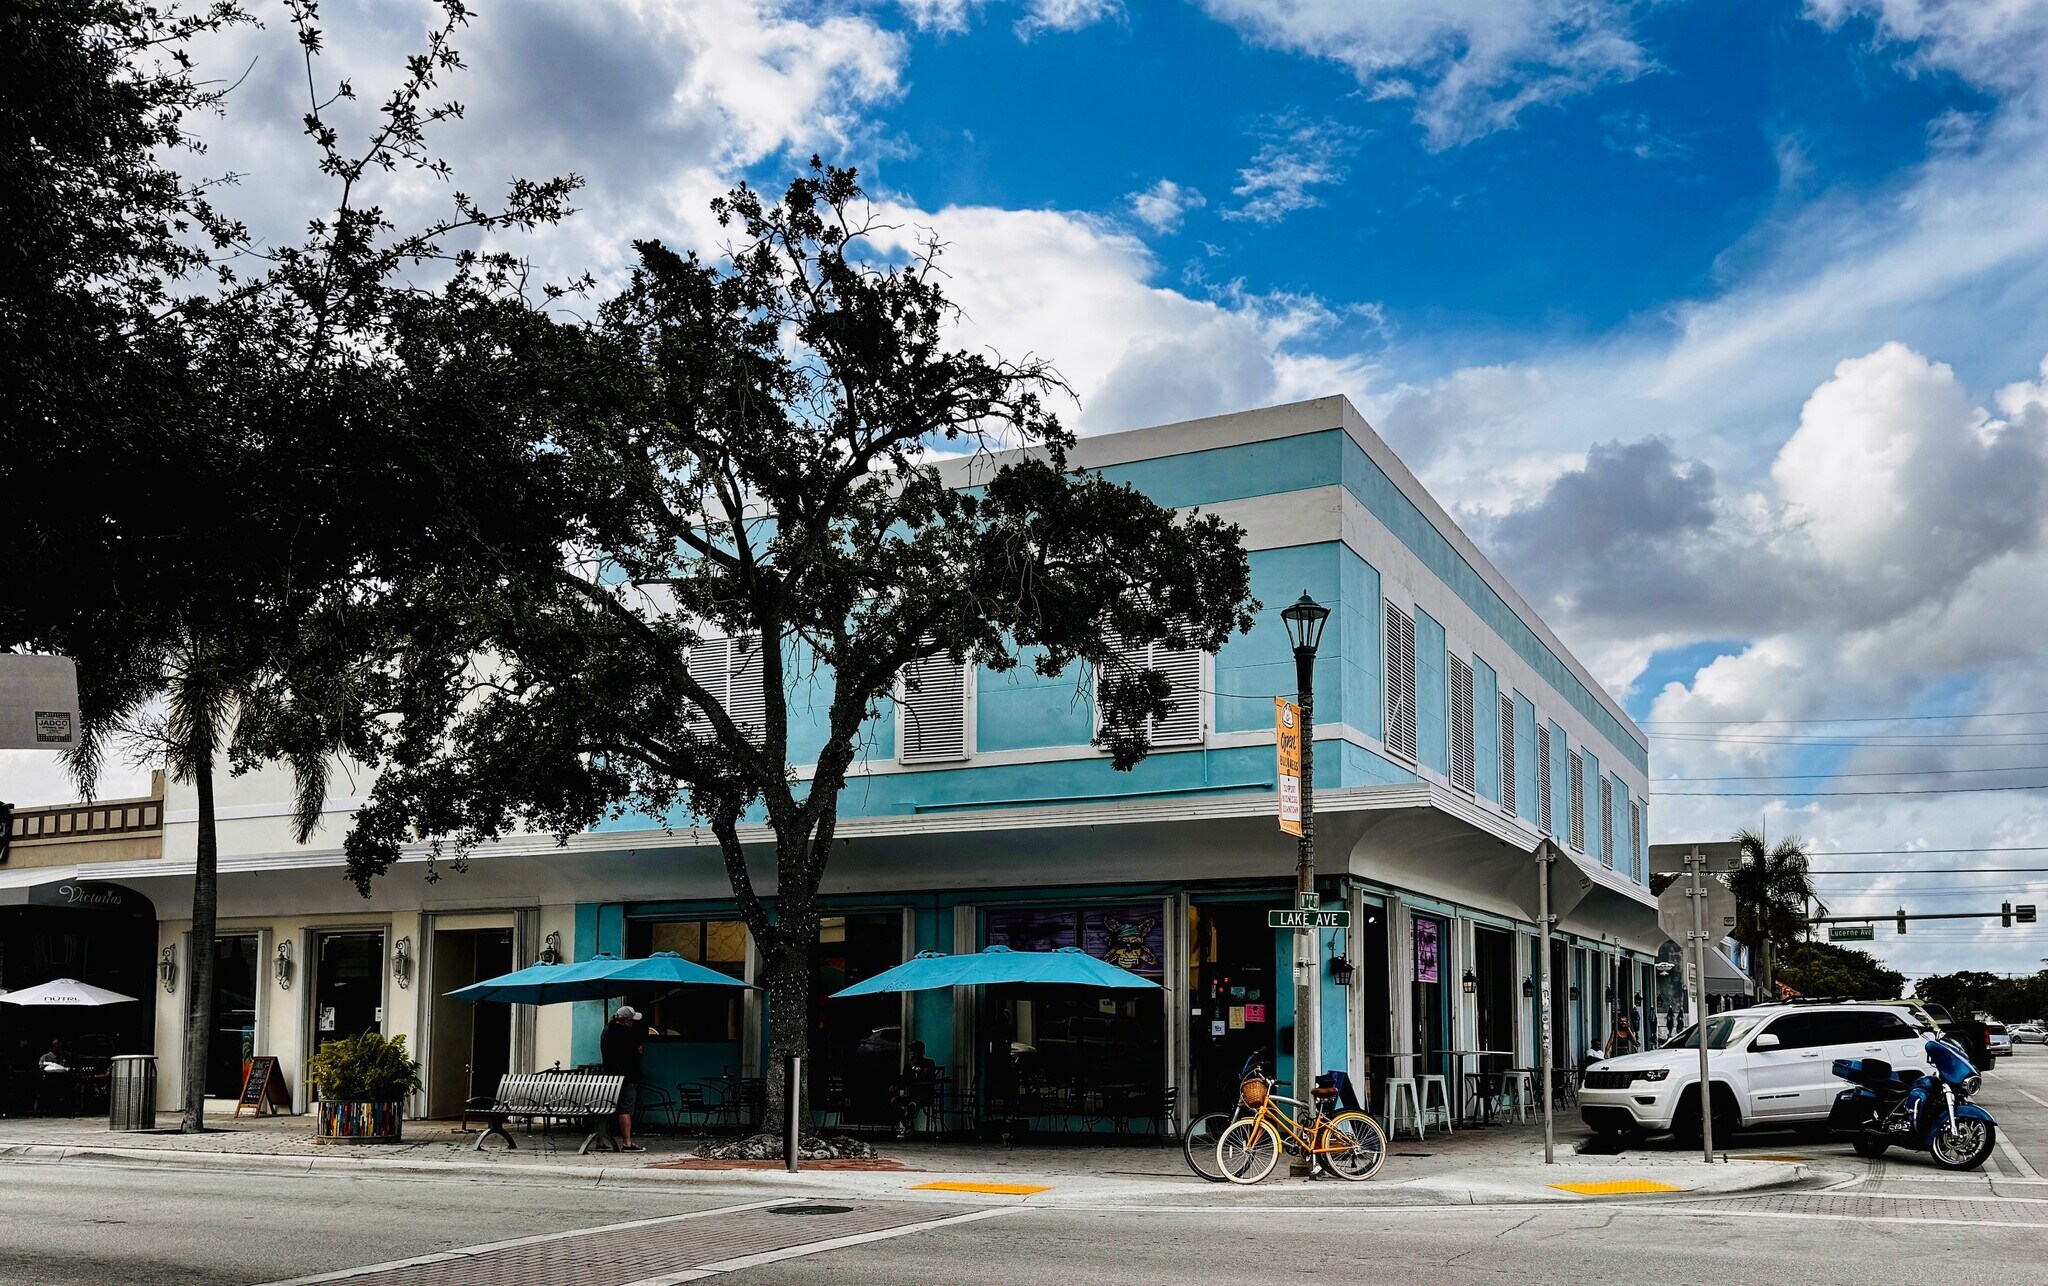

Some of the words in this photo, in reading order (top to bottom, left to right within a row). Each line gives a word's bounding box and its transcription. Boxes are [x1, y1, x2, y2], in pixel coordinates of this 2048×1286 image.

[1280, 912, 1310, 926] LAKE
[1316, 912, 1339, 926] AVE
[1830, 929, 1859, 937] Lucerne
[1860, 928, 1872, 936] Ave
